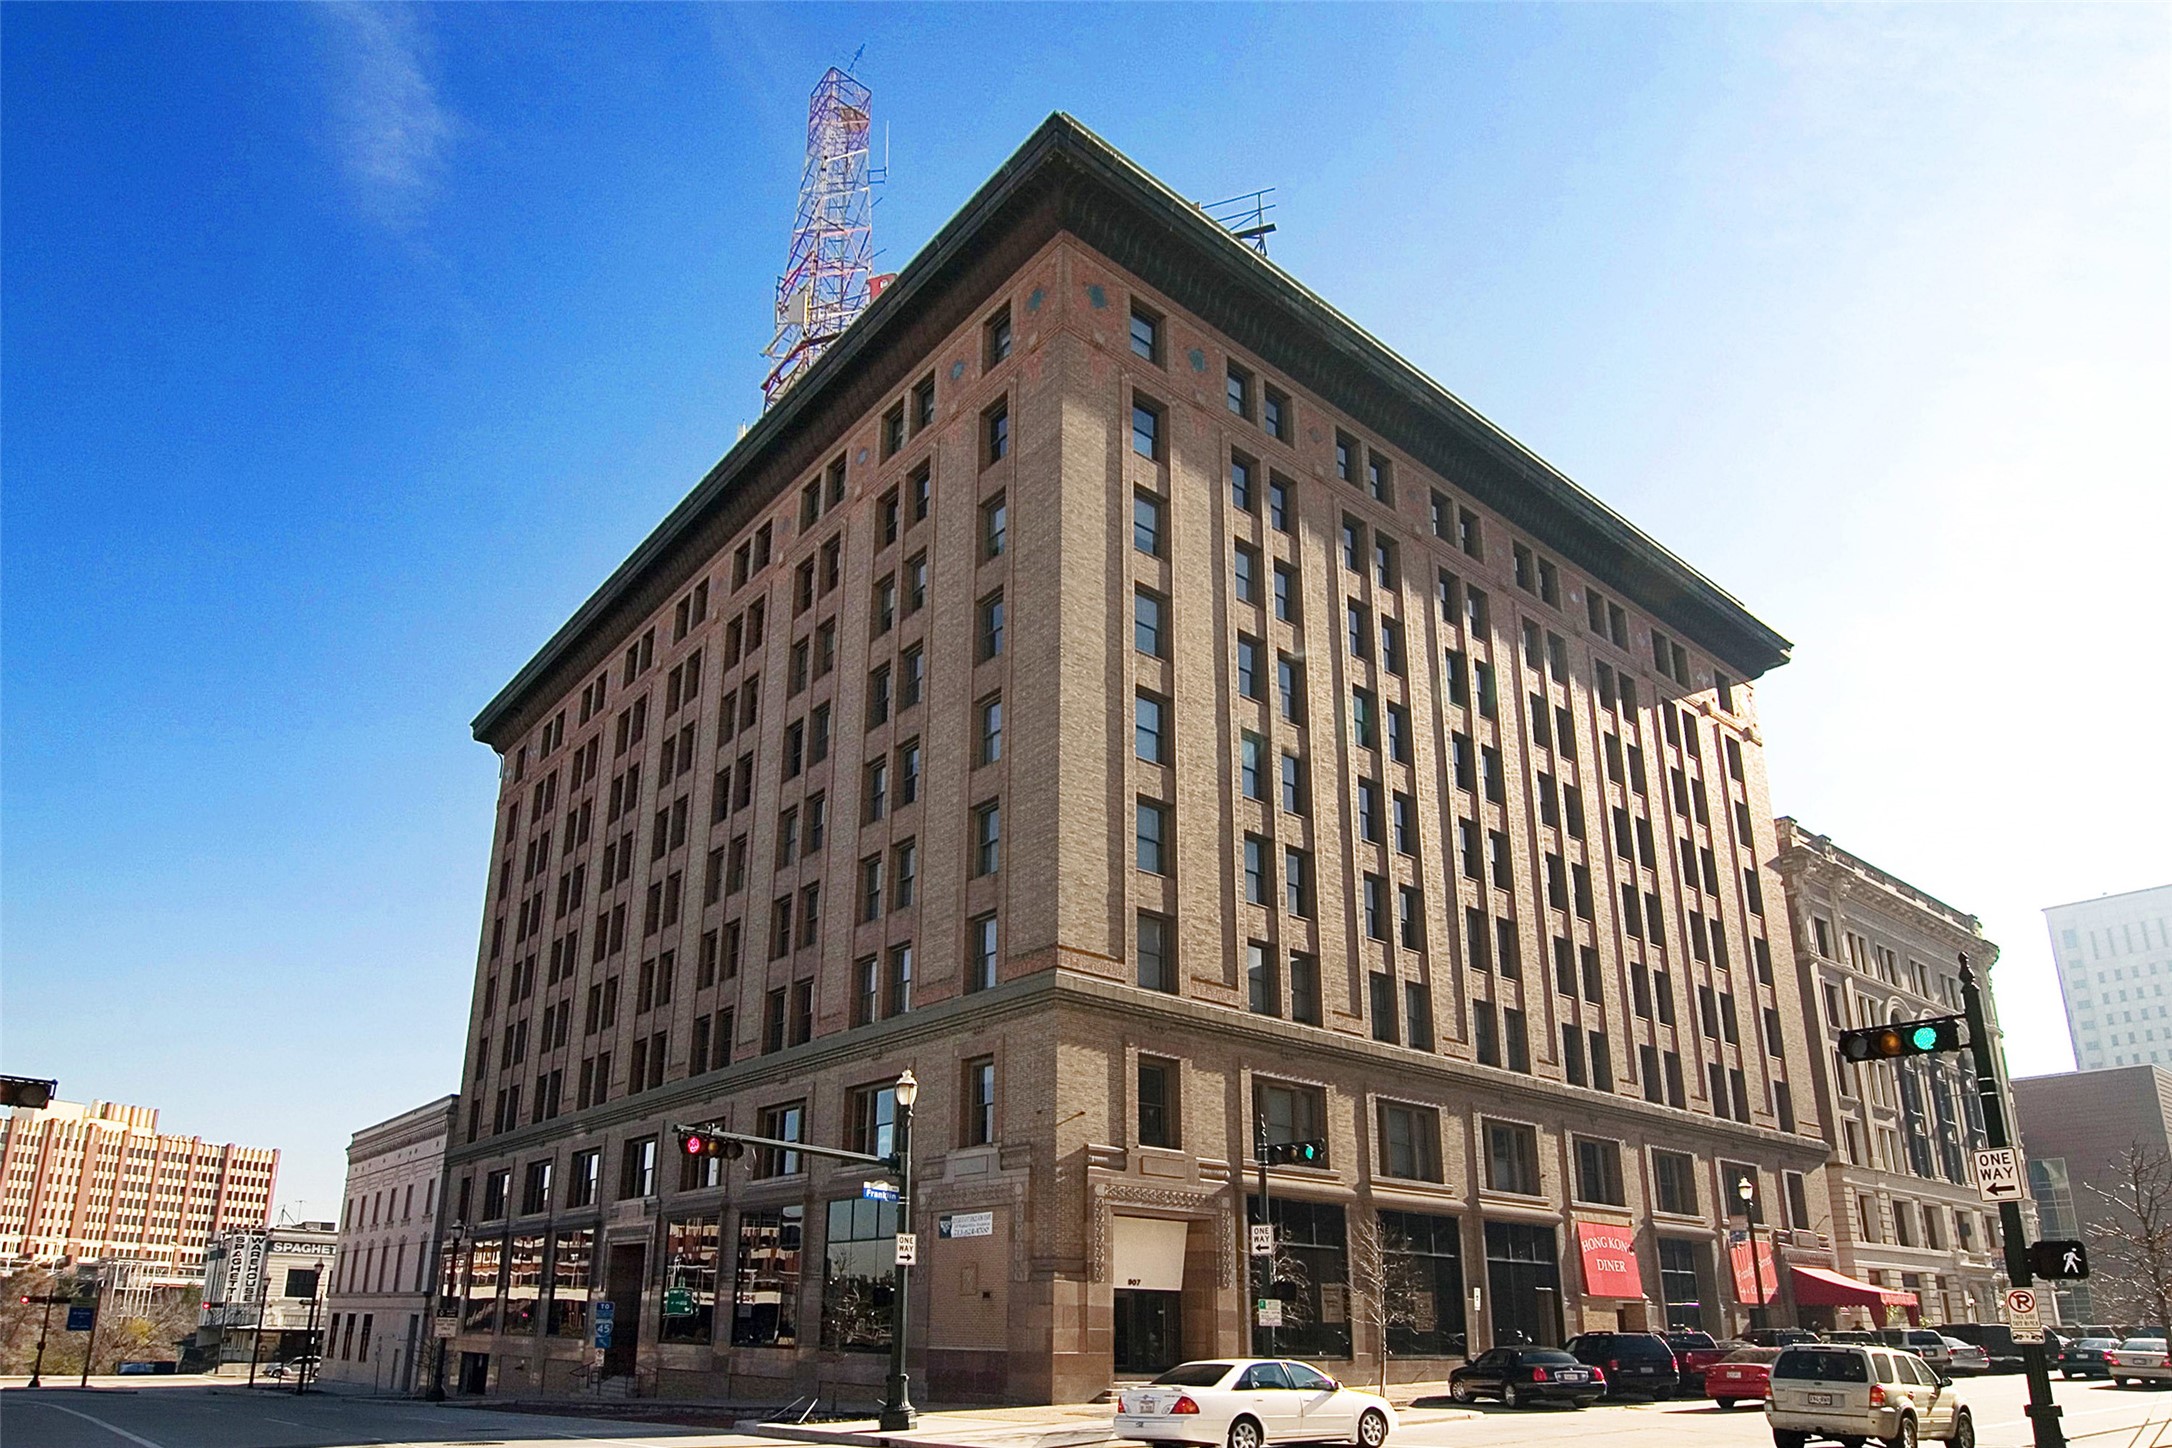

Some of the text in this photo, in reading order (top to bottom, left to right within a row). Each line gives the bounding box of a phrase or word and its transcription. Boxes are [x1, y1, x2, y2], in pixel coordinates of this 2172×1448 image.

[1979, 1152, 2012, 1166] ONE
[1980, 1166, 2013, 1181] WAY
[866, 1189, 897, 1199] Franklin
[1253, 1227, 1269, 1235] ONE
[898, 1236, 914, 1244] ONE
[1253, 1235, 1270, 1243] WAY
[1581, 1236, 1608, 1253] HONG
[228, 1236, 246, 1302] SPAGHETTI
[244, 1237, 266, 1302] WAREHOUSE
[1595, 1259, 1627, 1272] DINER
[597, 1324, 610, 1333] 45
